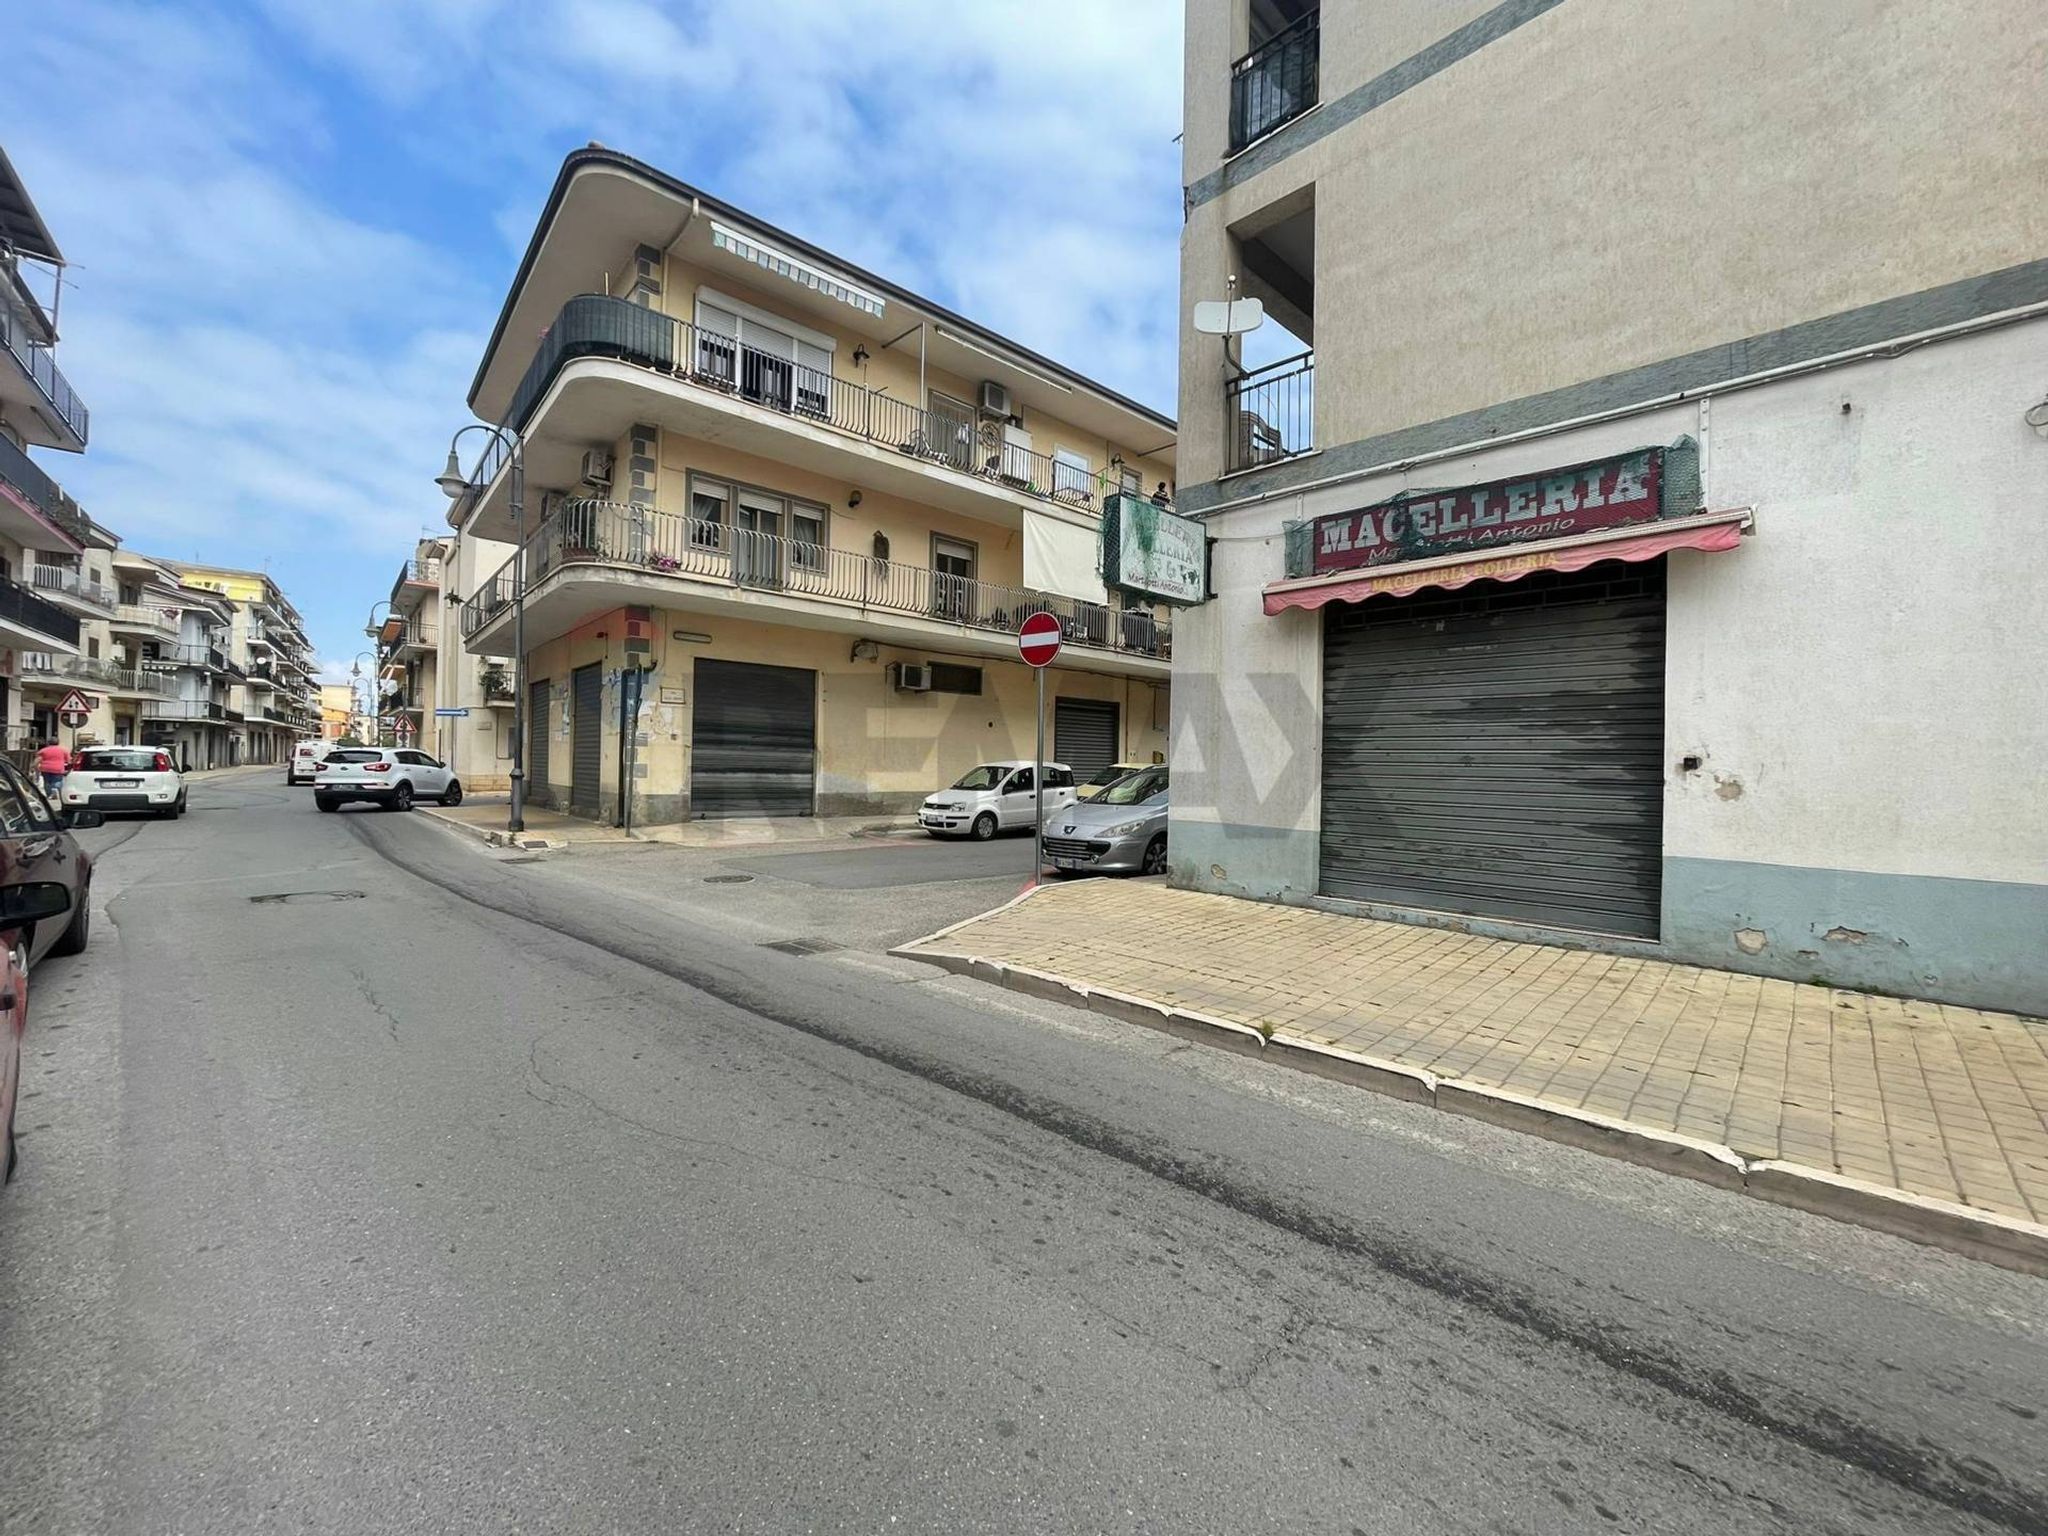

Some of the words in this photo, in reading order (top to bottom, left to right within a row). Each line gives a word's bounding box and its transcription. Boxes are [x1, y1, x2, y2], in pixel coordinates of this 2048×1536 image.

[1321, 455, 1650, 554] MACELLERIA
[1477, 518, 1576, 542] Antonio
[1371, 566, 1467, 592] MACELLERIA
